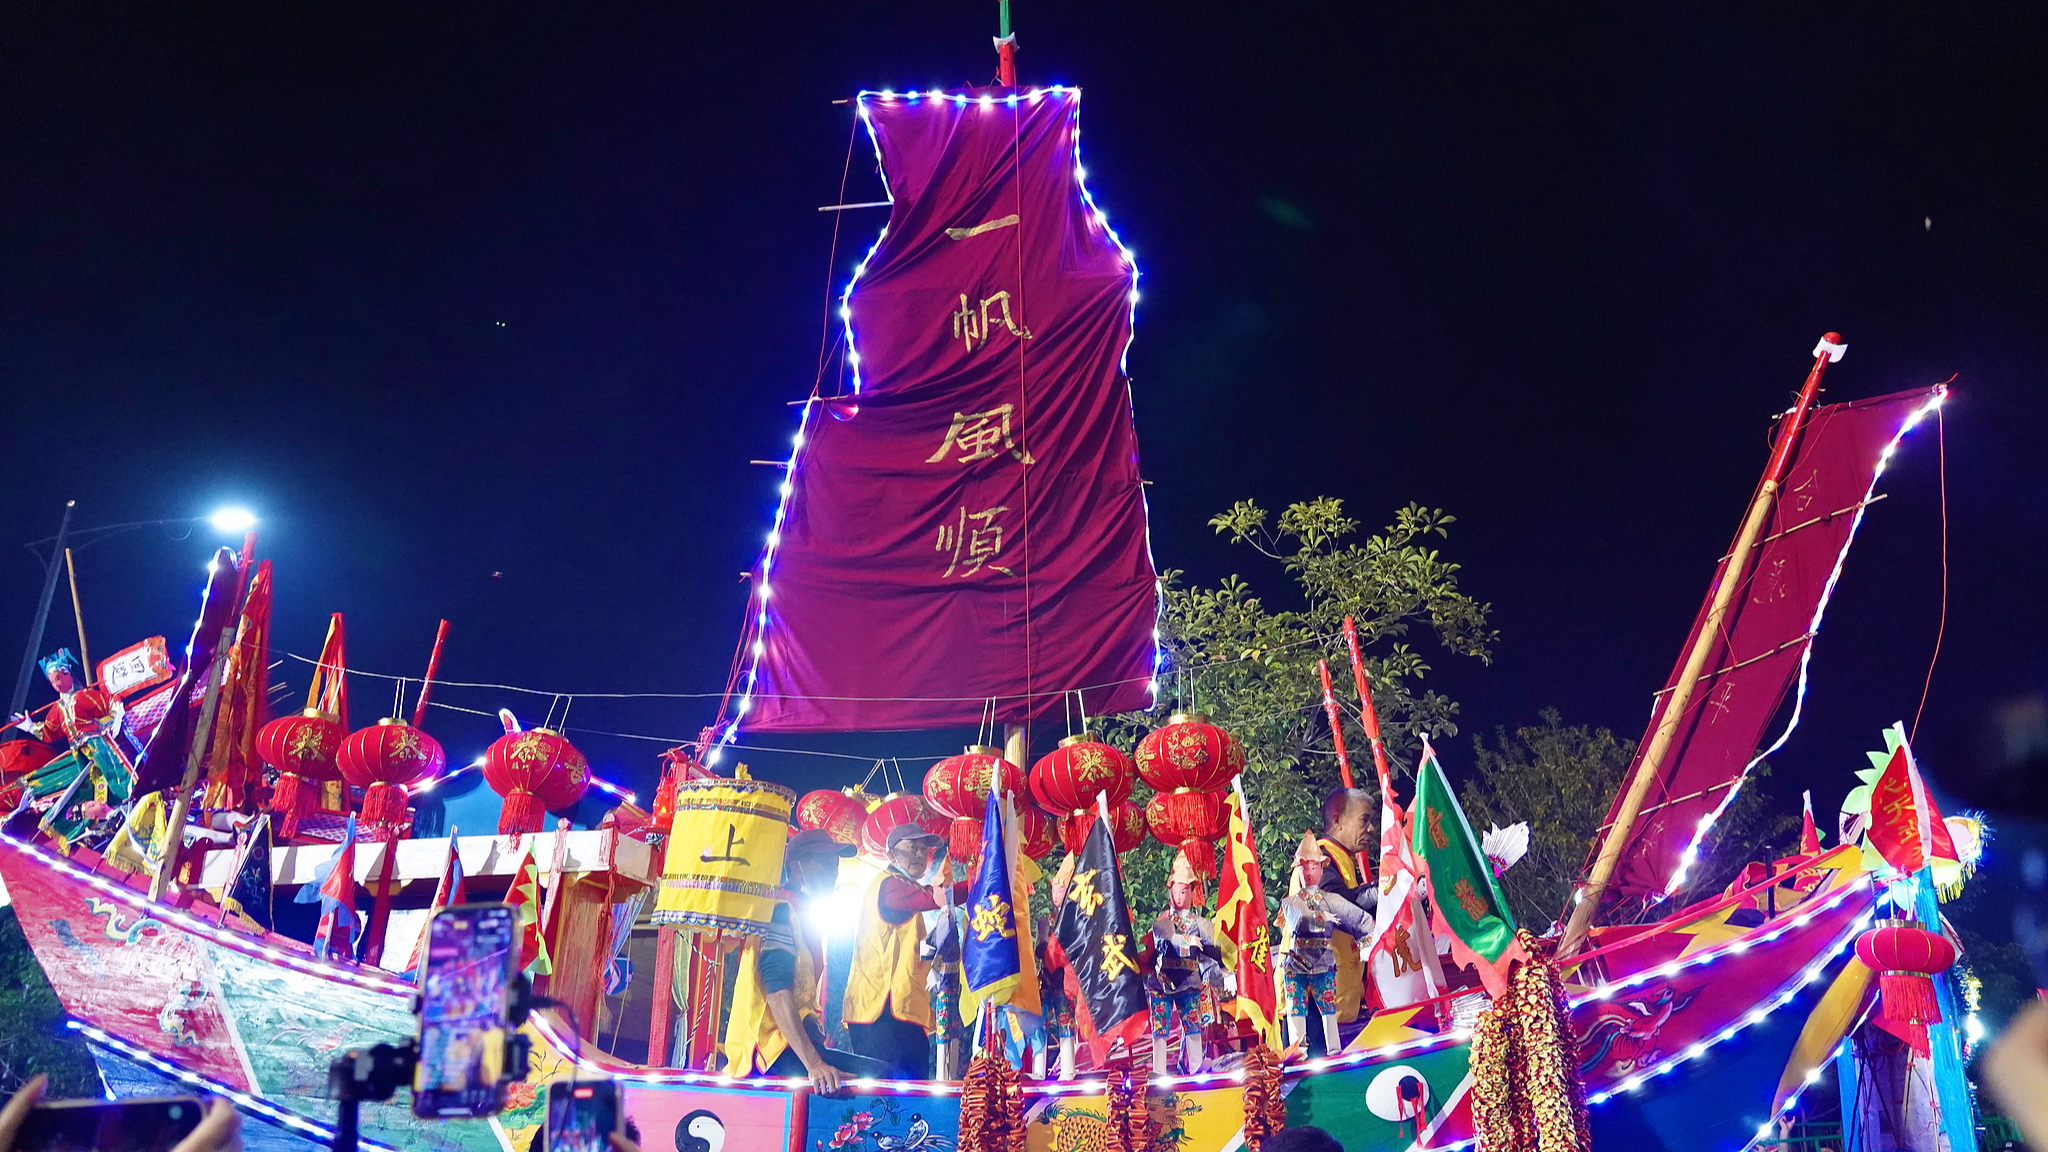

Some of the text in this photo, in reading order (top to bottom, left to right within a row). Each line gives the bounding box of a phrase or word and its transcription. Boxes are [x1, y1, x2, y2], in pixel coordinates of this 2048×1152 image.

[925, 213, 1036, 579] 一帆風順
[700, 823, 751, 867] 上
[1067, 867, 1141, 982] 玄武
